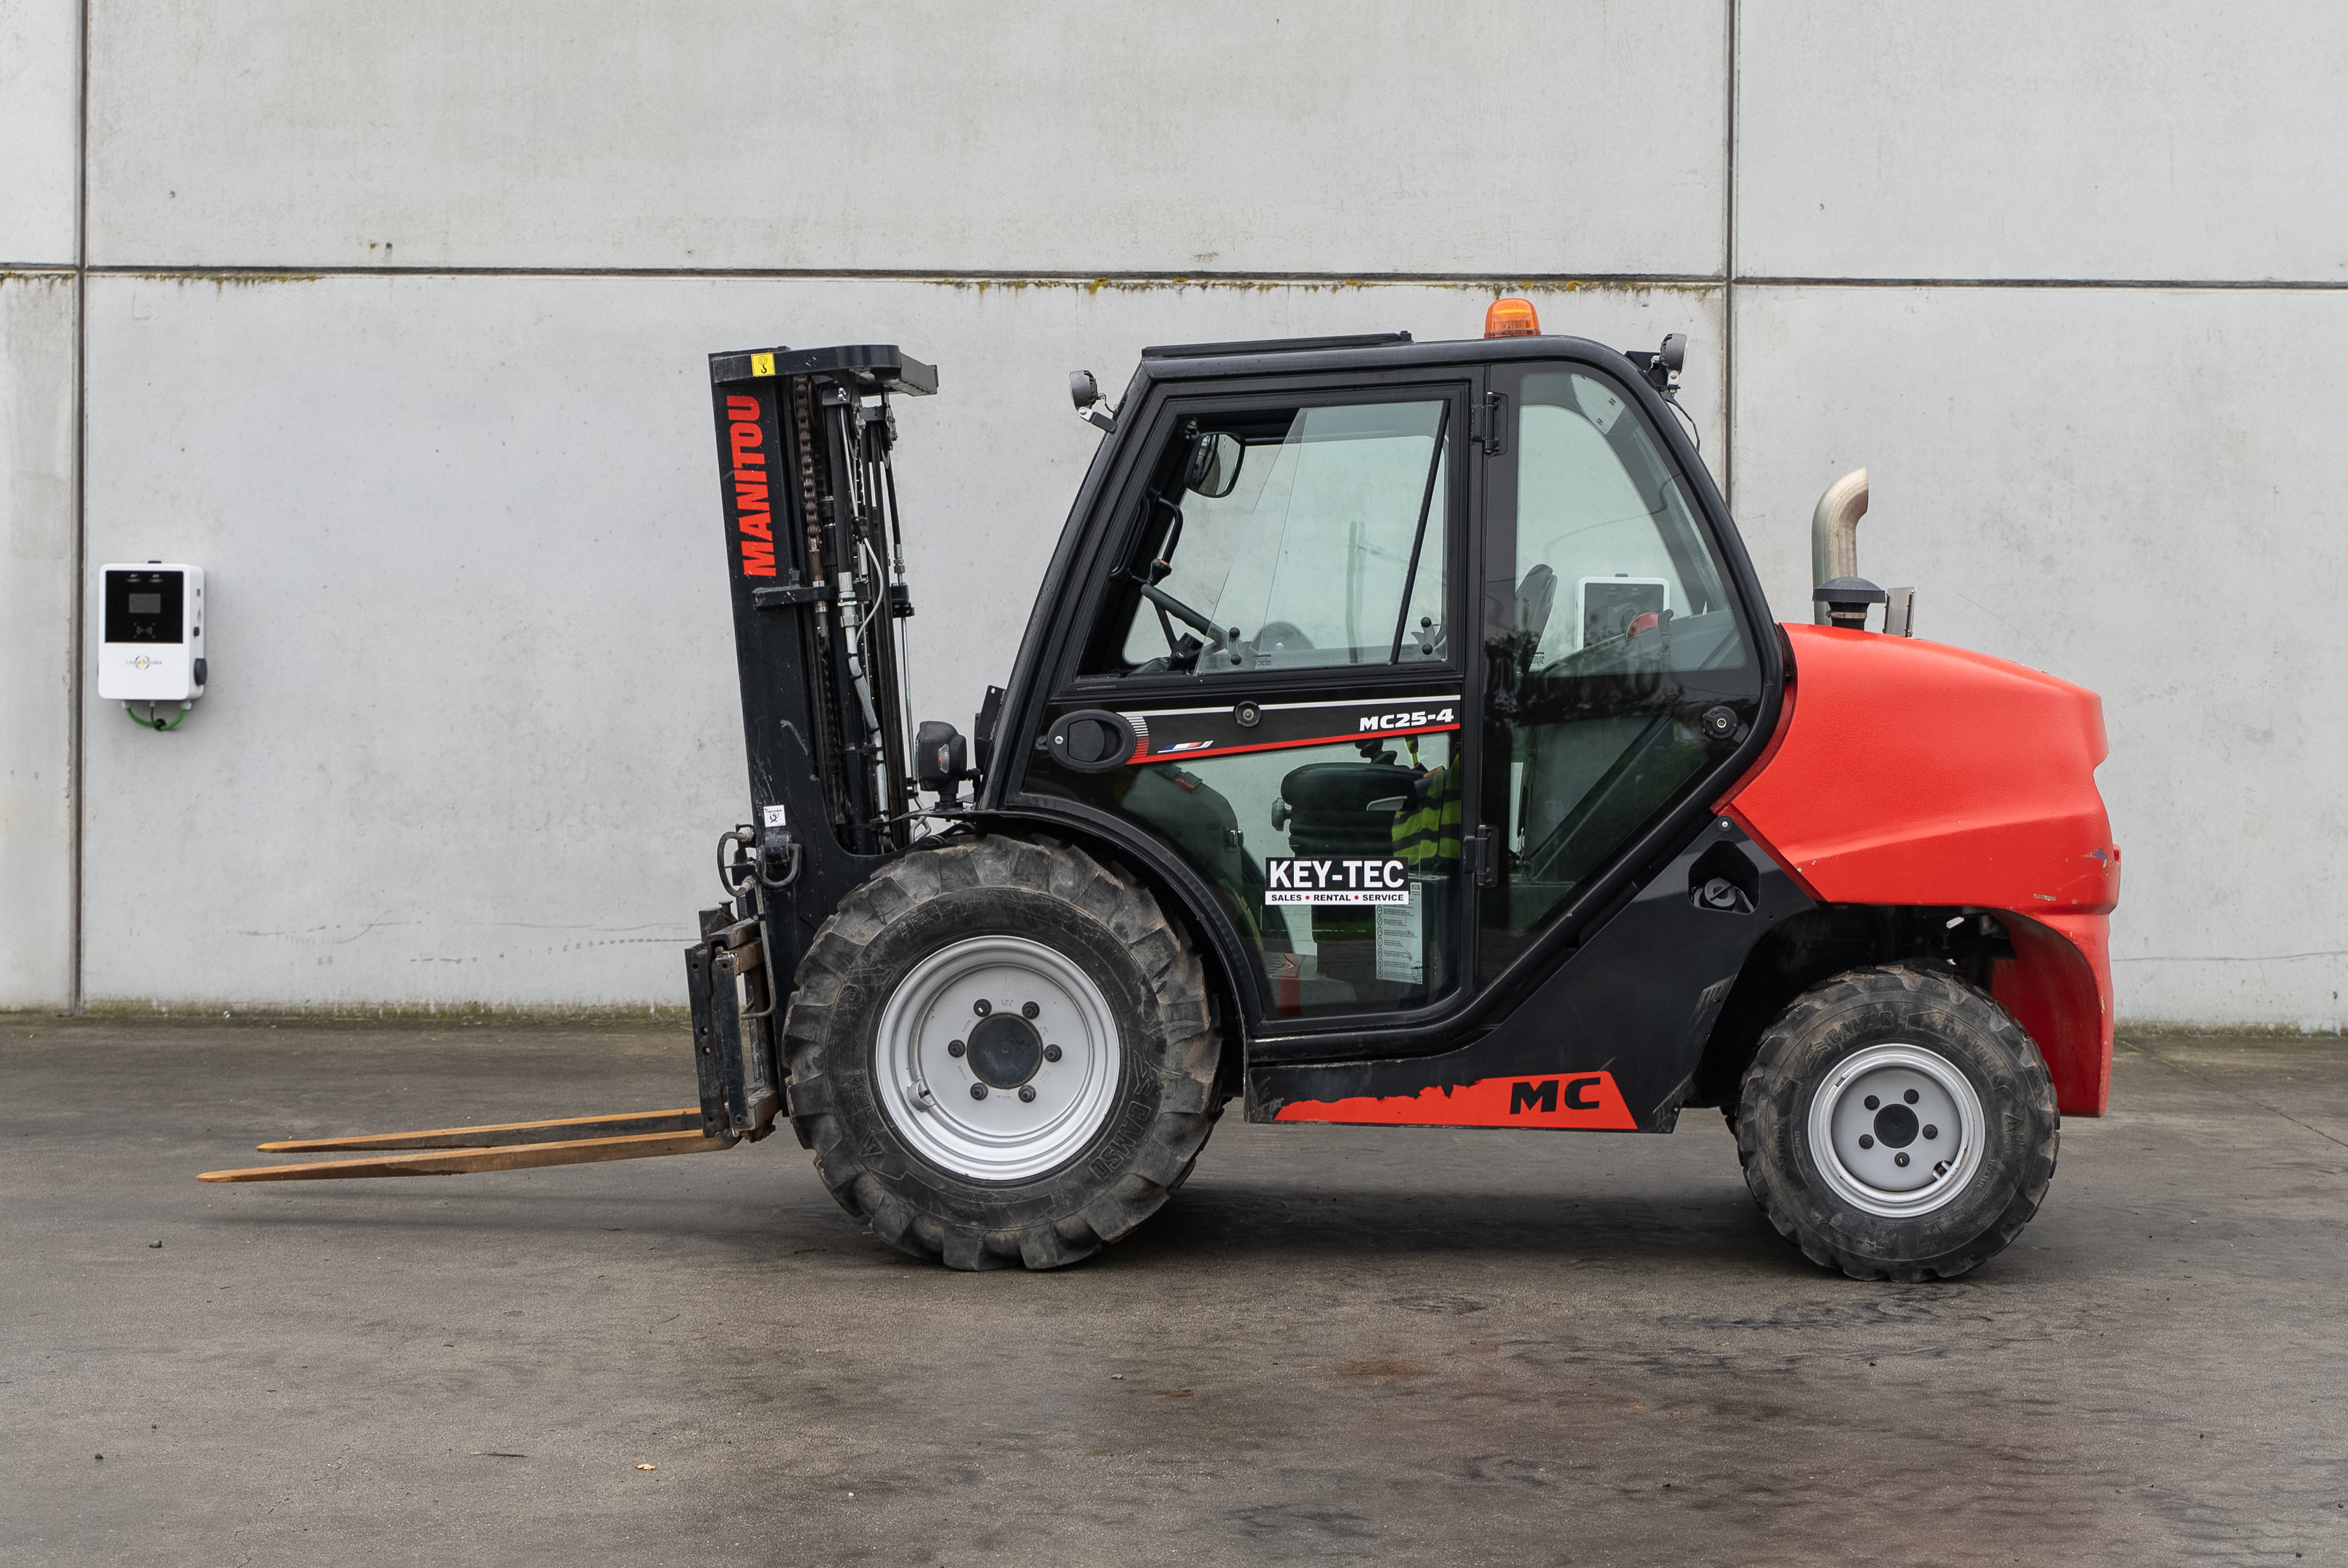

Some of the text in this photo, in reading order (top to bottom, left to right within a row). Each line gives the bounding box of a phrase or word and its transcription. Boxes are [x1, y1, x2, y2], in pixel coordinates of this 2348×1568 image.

[726, 395, 776, 577] MANITOU
[1359, 708, 1454, 731] MC25-4
[1270, 860, 1405, 888] KEY-TEC
[1826, 1011, 1893, 1045] CAMSO
[1509, 1077, 1601, 1115] MC
[1088, 1101, 1152, 1181] CAMSO
